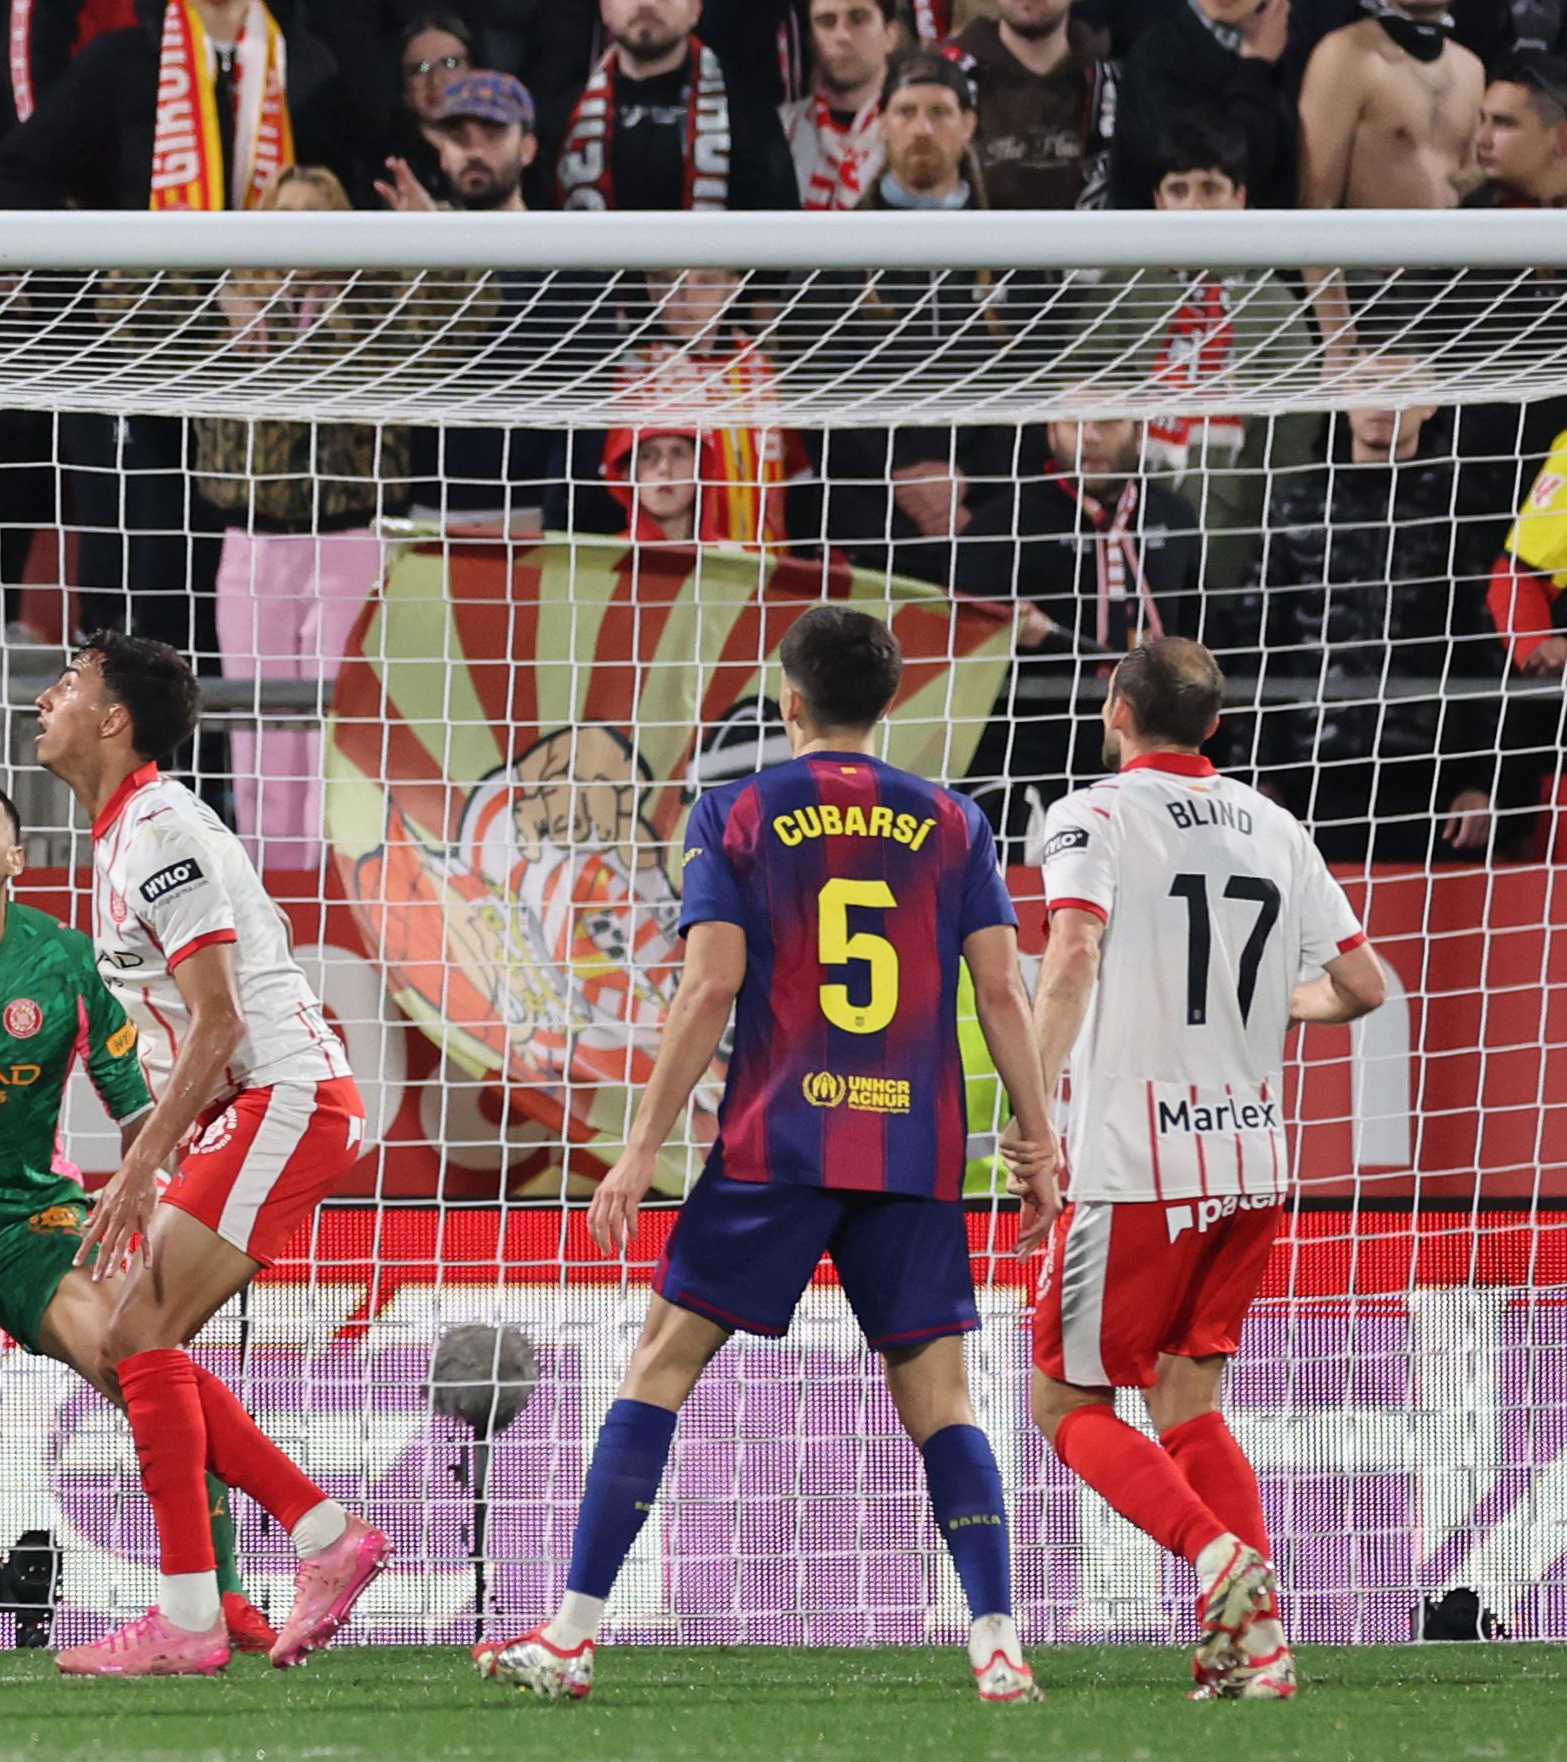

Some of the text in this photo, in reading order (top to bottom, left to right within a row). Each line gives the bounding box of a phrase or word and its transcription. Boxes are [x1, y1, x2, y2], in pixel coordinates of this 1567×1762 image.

[772, 805, 938, 852] CUBARSÍ
[1167, 799, 1252, 835] BLIND
[818, 878, 900, 1034] 5
[1167, 873, 1282, 1031] 17
[848, 1076, 910, 1094] UNHCR
[848, 1091, 910, 1107] ACNUR
[1159, 1098, 1277, 1134] Marlex
